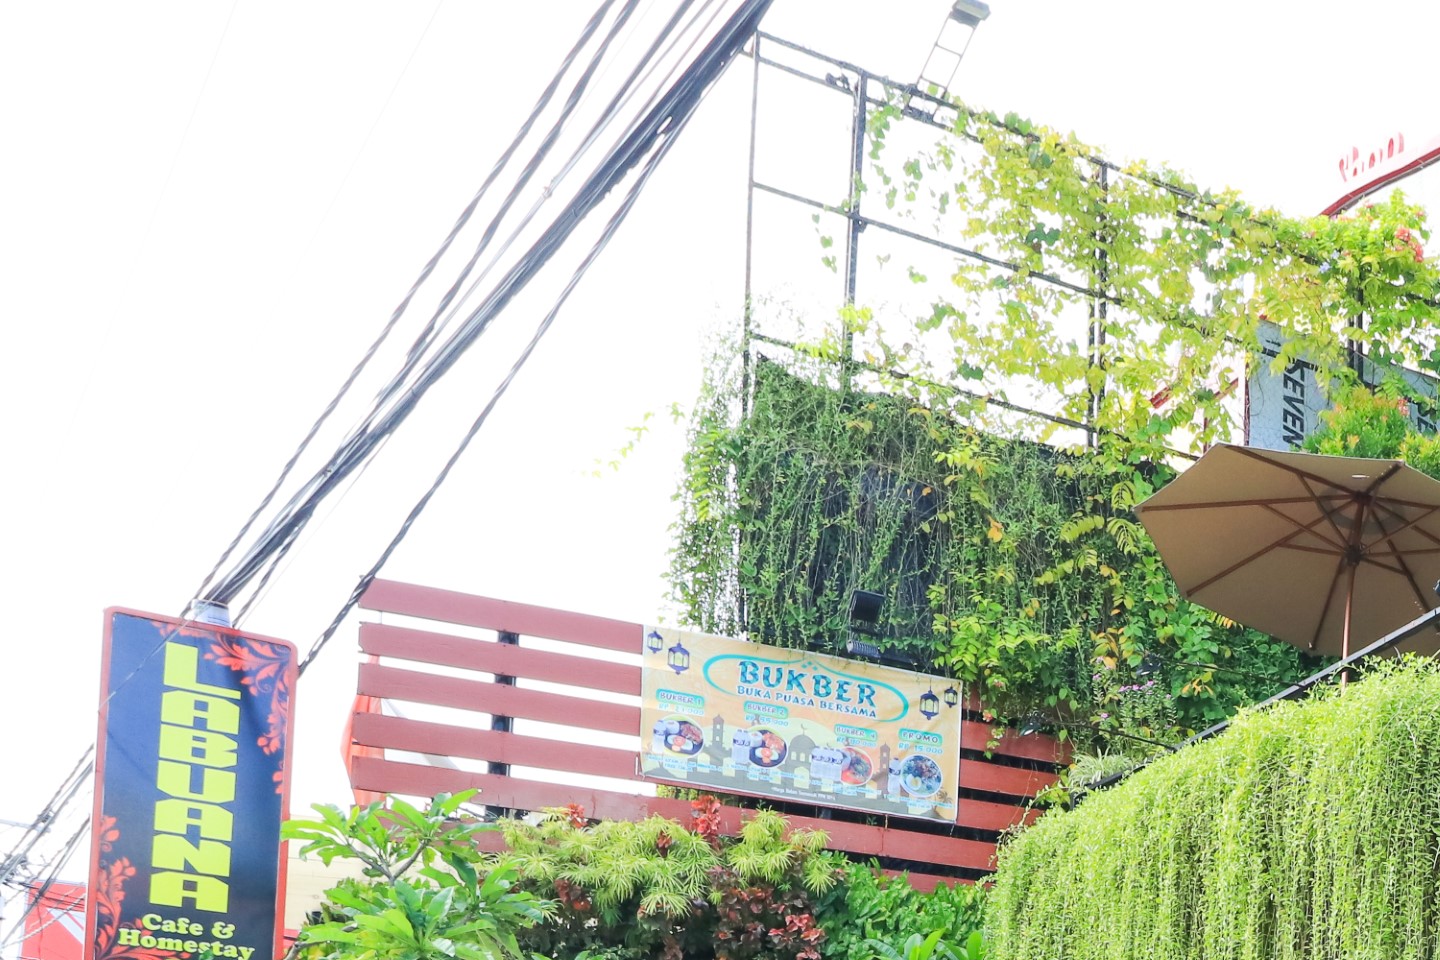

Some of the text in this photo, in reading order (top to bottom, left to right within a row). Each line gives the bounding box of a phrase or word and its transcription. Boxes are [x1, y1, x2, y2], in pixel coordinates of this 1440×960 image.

[738, 660, 877, 708] BUKBER
[659, 691, 694, 705] BUKBER
[737, 684, 877, 719] BUKA PUASA BERSAMA
[746, 703, 776, 714] BUKBER
[836, 726, 865, 738] BUKBER
[902, 731, 939, 744] PROMO
[149, 641, 241, 913] LABUANA
[142, 913, 236, 939] Cafe &
